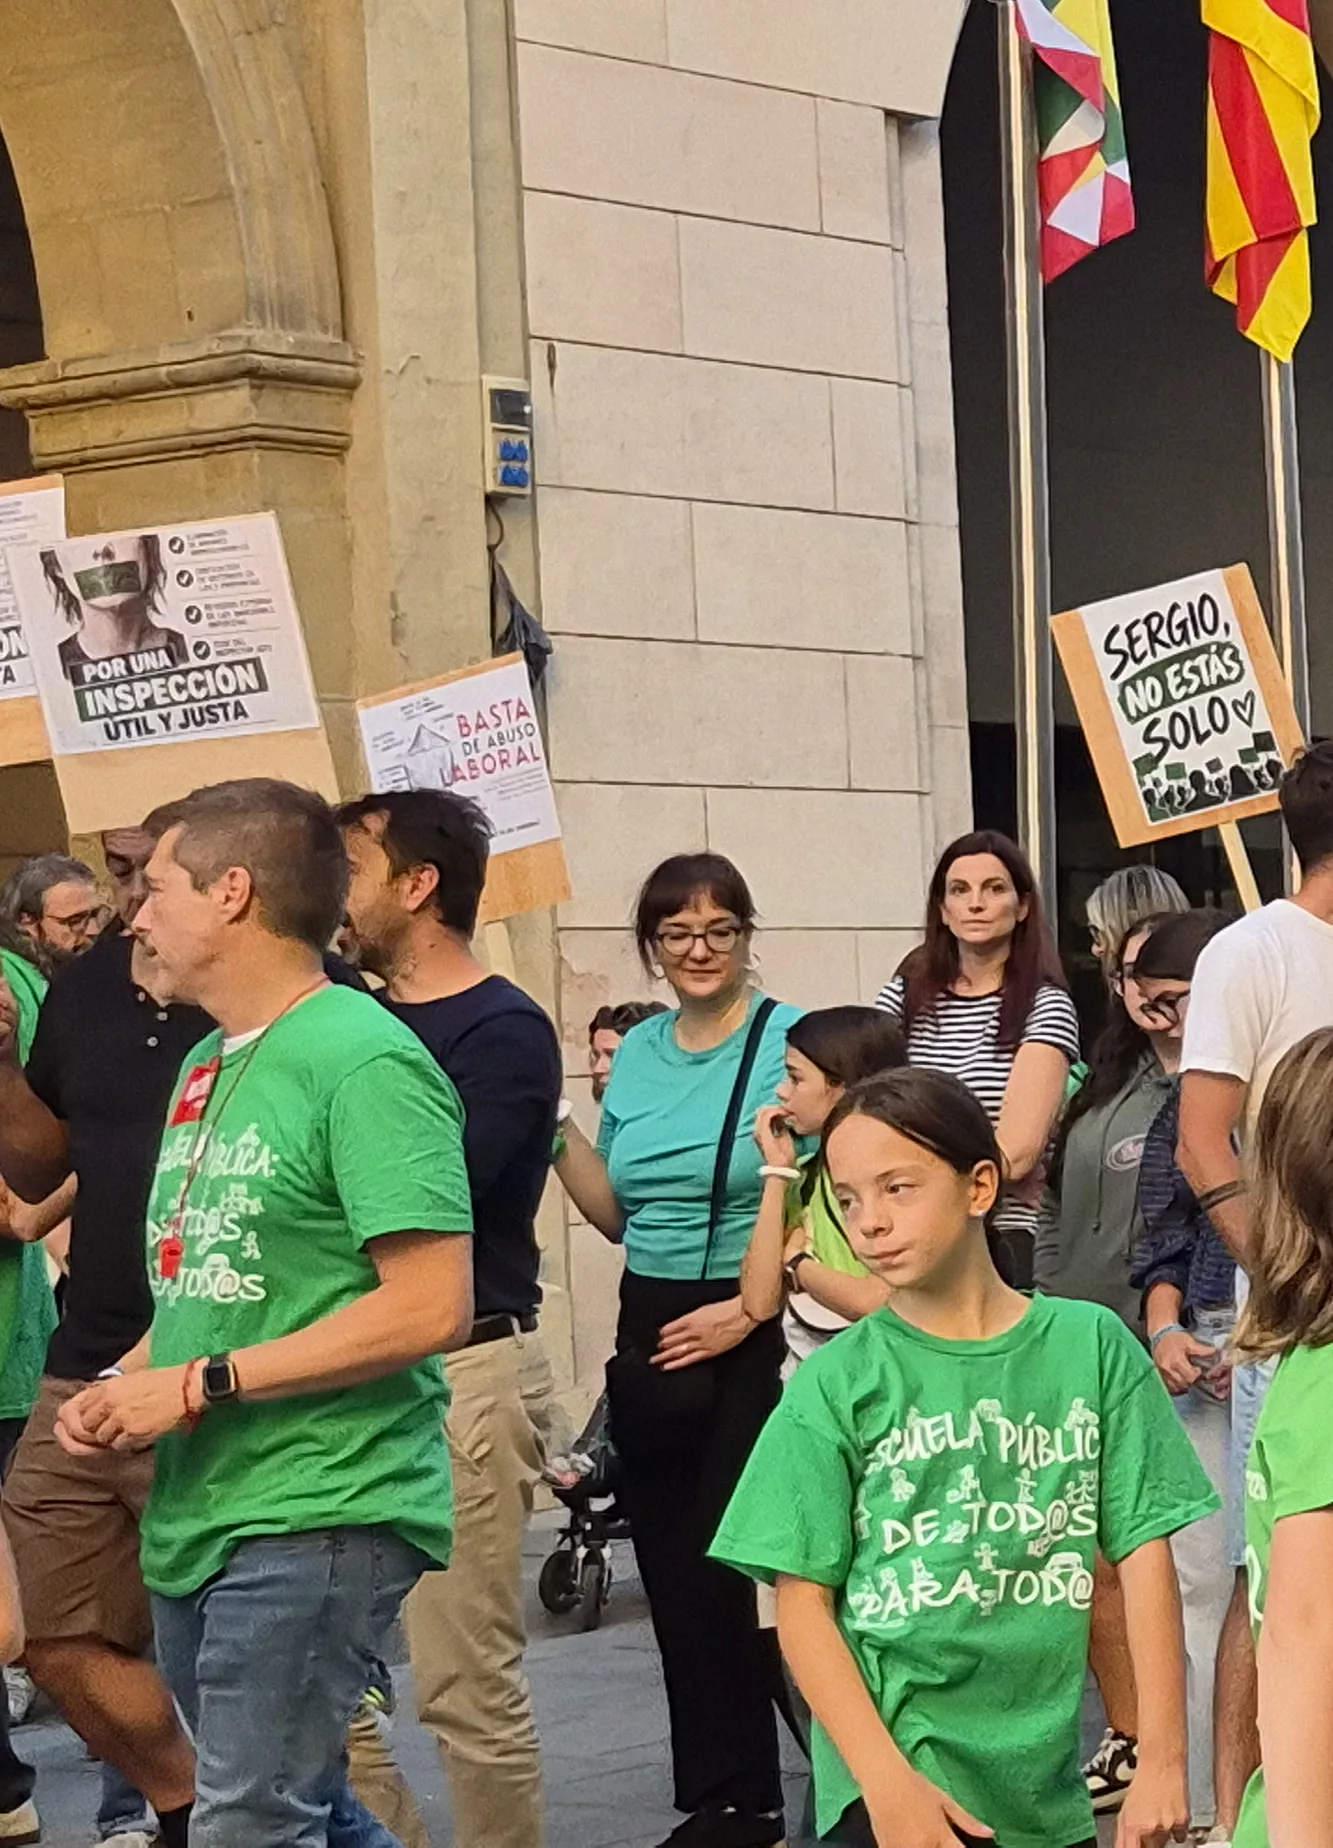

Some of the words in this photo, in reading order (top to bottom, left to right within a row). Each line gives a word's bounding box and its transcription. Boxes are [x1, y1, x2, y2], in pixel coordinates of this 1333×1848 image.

[1103, 592, 1230, 681] SERGIO,
[82, 657, 127, 684] POR
[129, 649, 173, 675] UNA
[1124, 676, 1163, 718] NO
[1165, 644, 1241, 701] ESTÁS
[84, 662, 261, 718] INSPECCIÓN
[158, 712, 173, 732] Y
[178, 699, 250, 730] JUSTA
[456, 697, 532, 739] BASTA
[1142, 696, 1229, 763] SOLO
[462, 741, 481, 758] DE
[487, 722, 537, 750] ABUSO
[440, 741, 541, 788] LABORAL
[881, 1509, 940, 1555] DE
[990, 1568, 1095, 1610] TOD@
